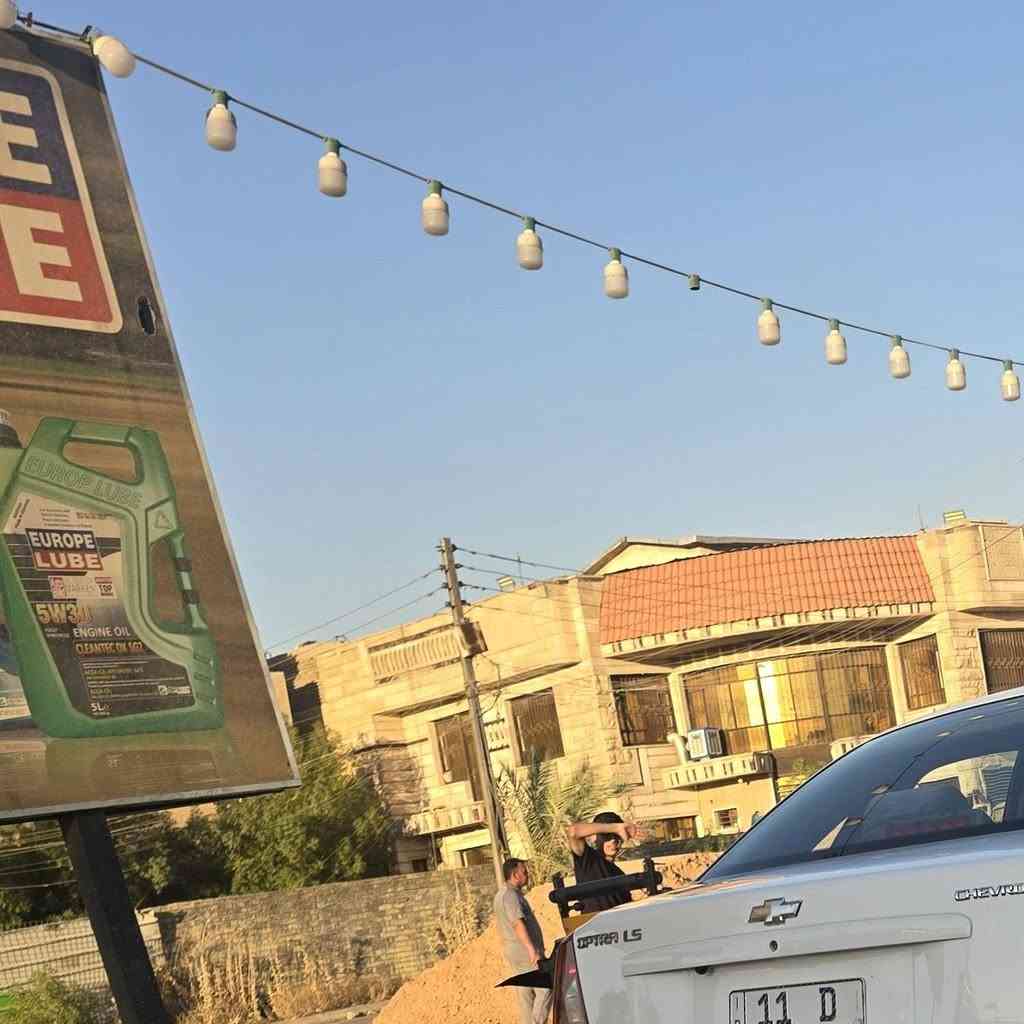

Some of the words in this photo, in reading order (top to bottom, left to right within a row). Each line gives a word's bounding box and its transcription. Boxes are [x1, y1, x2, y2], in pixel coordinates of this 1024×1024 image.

[0, 203, 83, 303] E
[28, 531, 95, 550] EUROPE
[35, 551, 102, 569] LUBE
[73, 627, 113, 638] ENGINE
[113, 626, 130, 637] OIL
[577, 931, 619, 949] OPTRA
[623, 928, 642, 943] LS
[819, 986, 837, 1022] D
